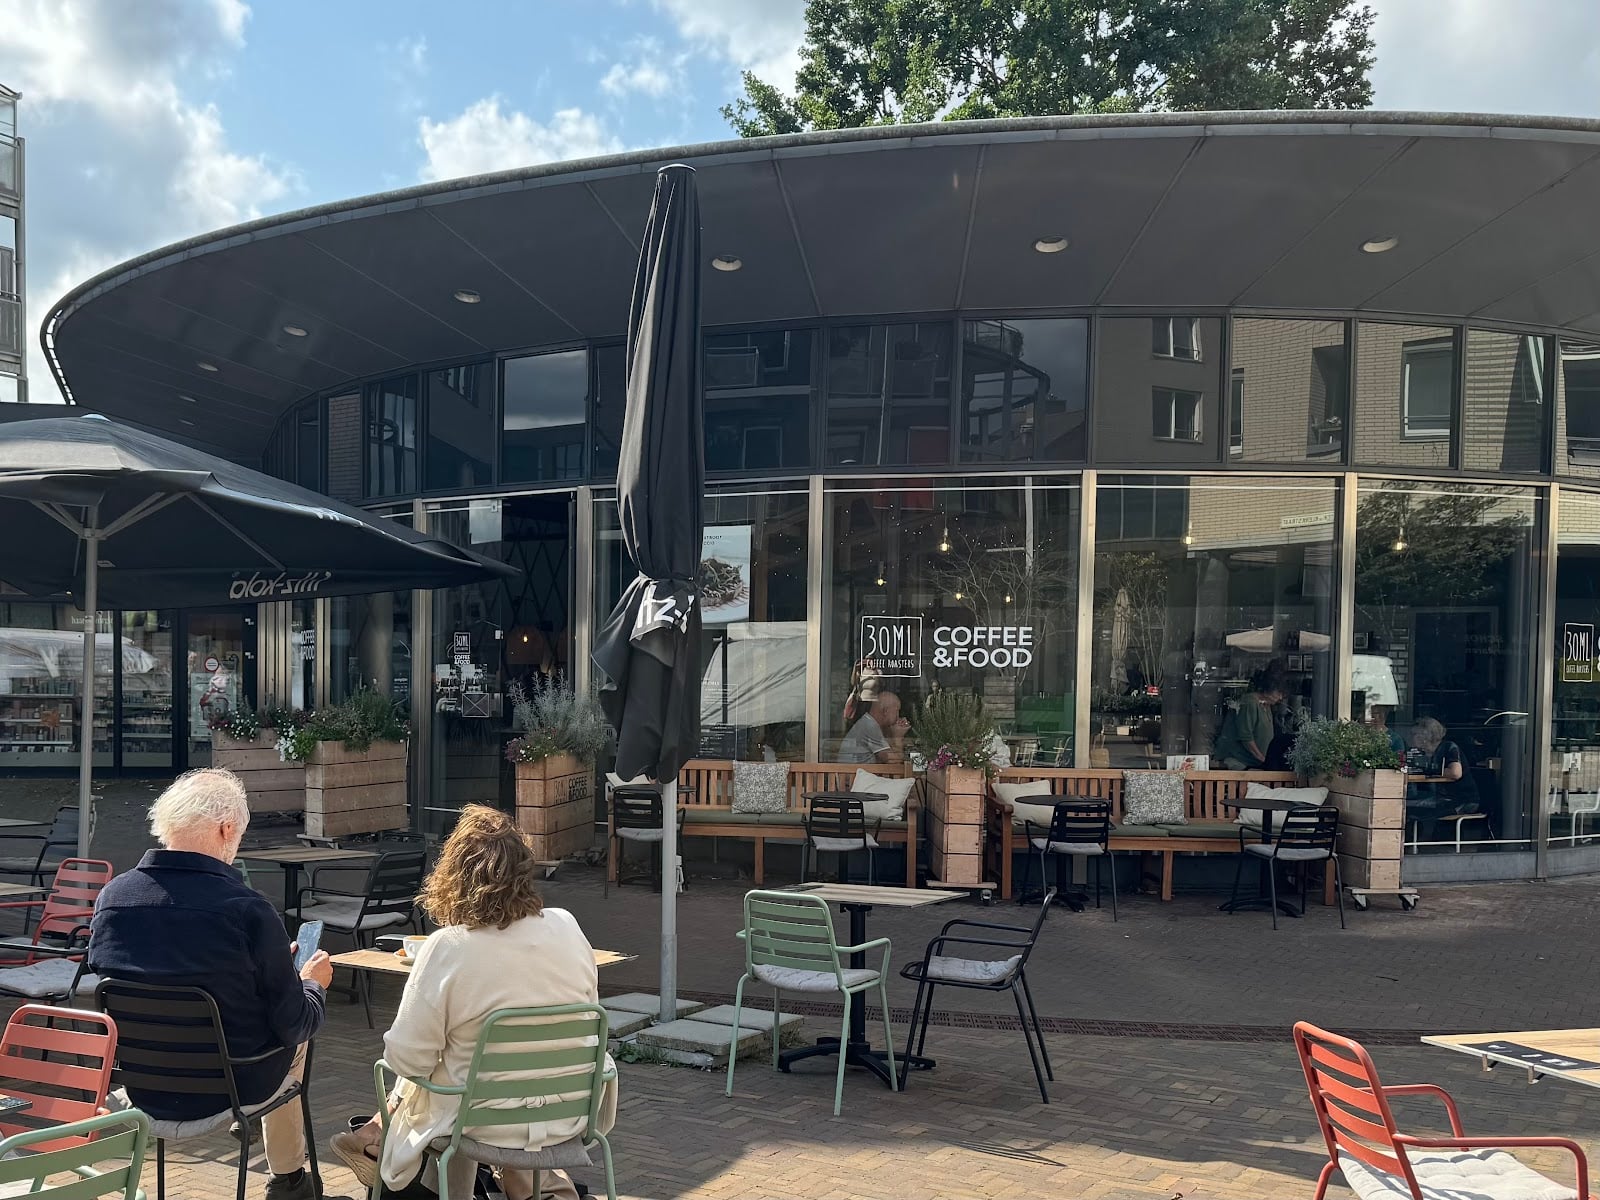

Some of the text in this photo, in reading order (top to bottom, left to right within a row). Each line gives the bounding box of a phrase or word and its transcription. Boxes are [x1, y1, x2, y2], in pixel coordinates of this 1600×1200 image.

[455, 635, 469, 646] 30ML
[866, 624, 915, 656] 30ML
[933, 626, 1033, 646] COFFEE
[1567, 631, 1590, 661] 30ML
[887, 658, 915, 669] ROASTERS
[932, 647, 1033, 668] &FOOD
[569, 776, 588, 789] COFFEE
